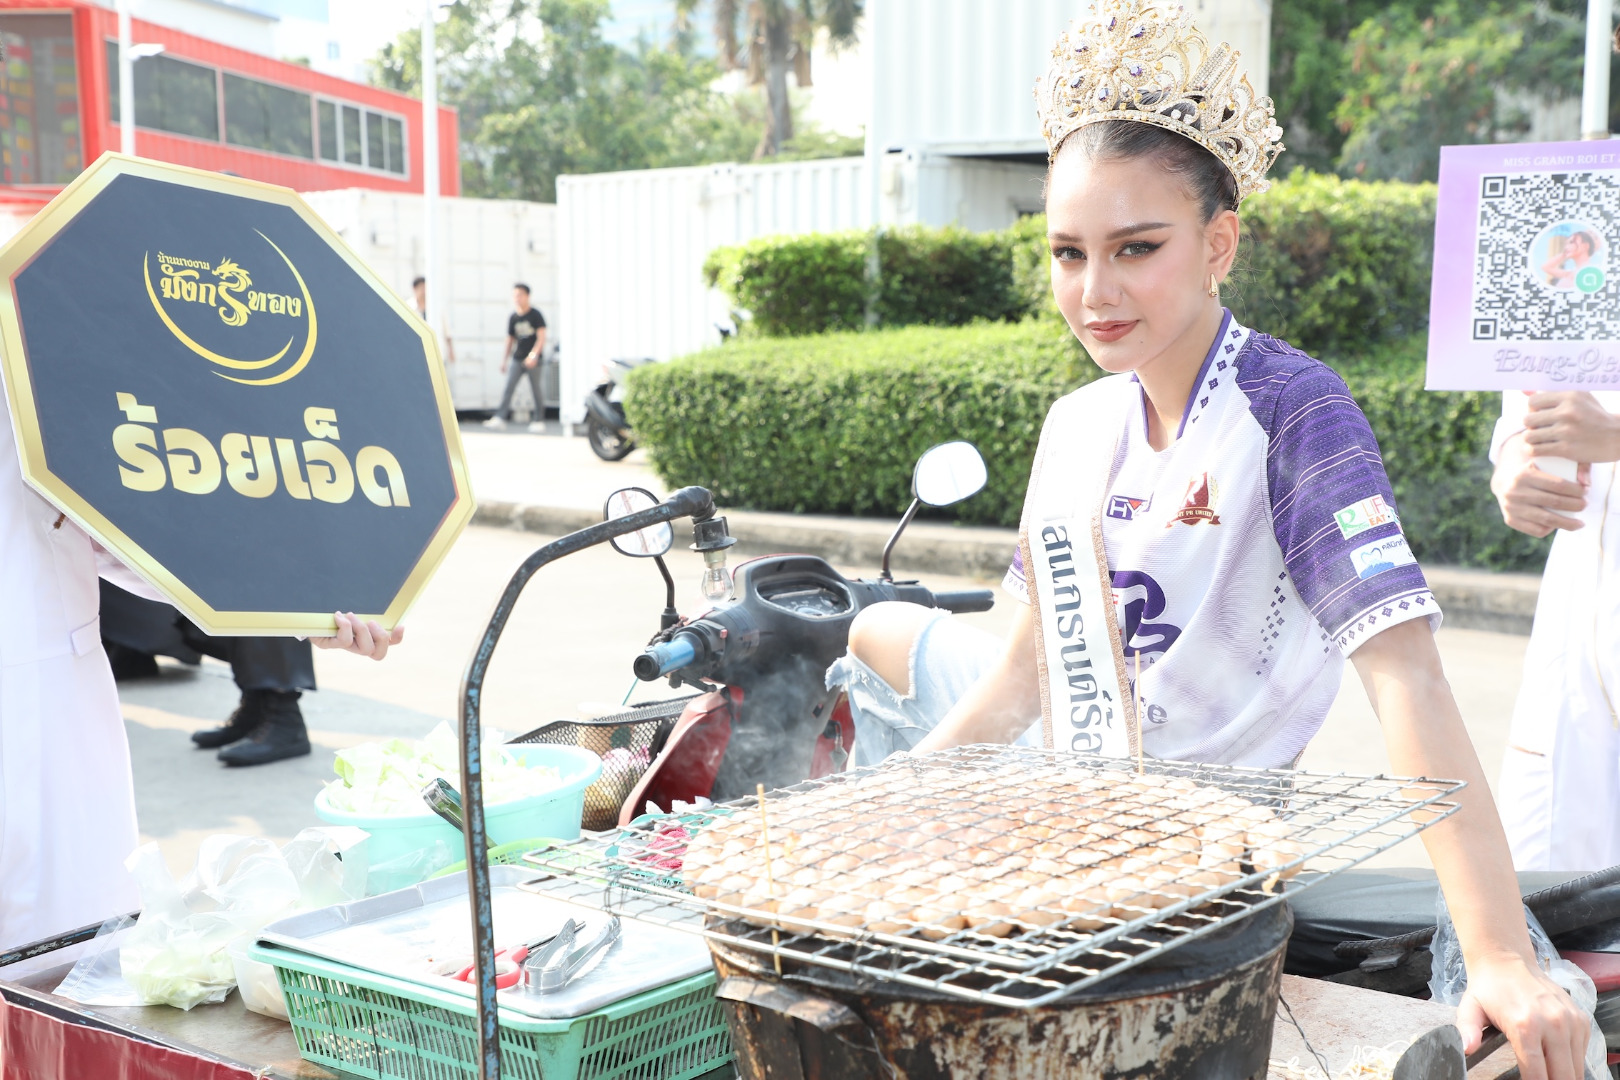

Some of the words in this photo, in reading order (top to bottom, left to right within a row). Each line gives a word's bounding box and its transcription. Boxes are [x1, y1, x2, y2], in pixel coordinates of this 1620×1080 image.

[1503, 157, 1531, 168] MISS
[1533, 156, 1574, 167] GRAND
[1577, 154, 1598, 165] ROI
[1600, 153, 1616, 164] ET
[160, 257, 302, 327] มังกรทอง
[112, 391, 411, 508] ร้อยเอ็ด
[1369, 514, 1386, 527] EAT
